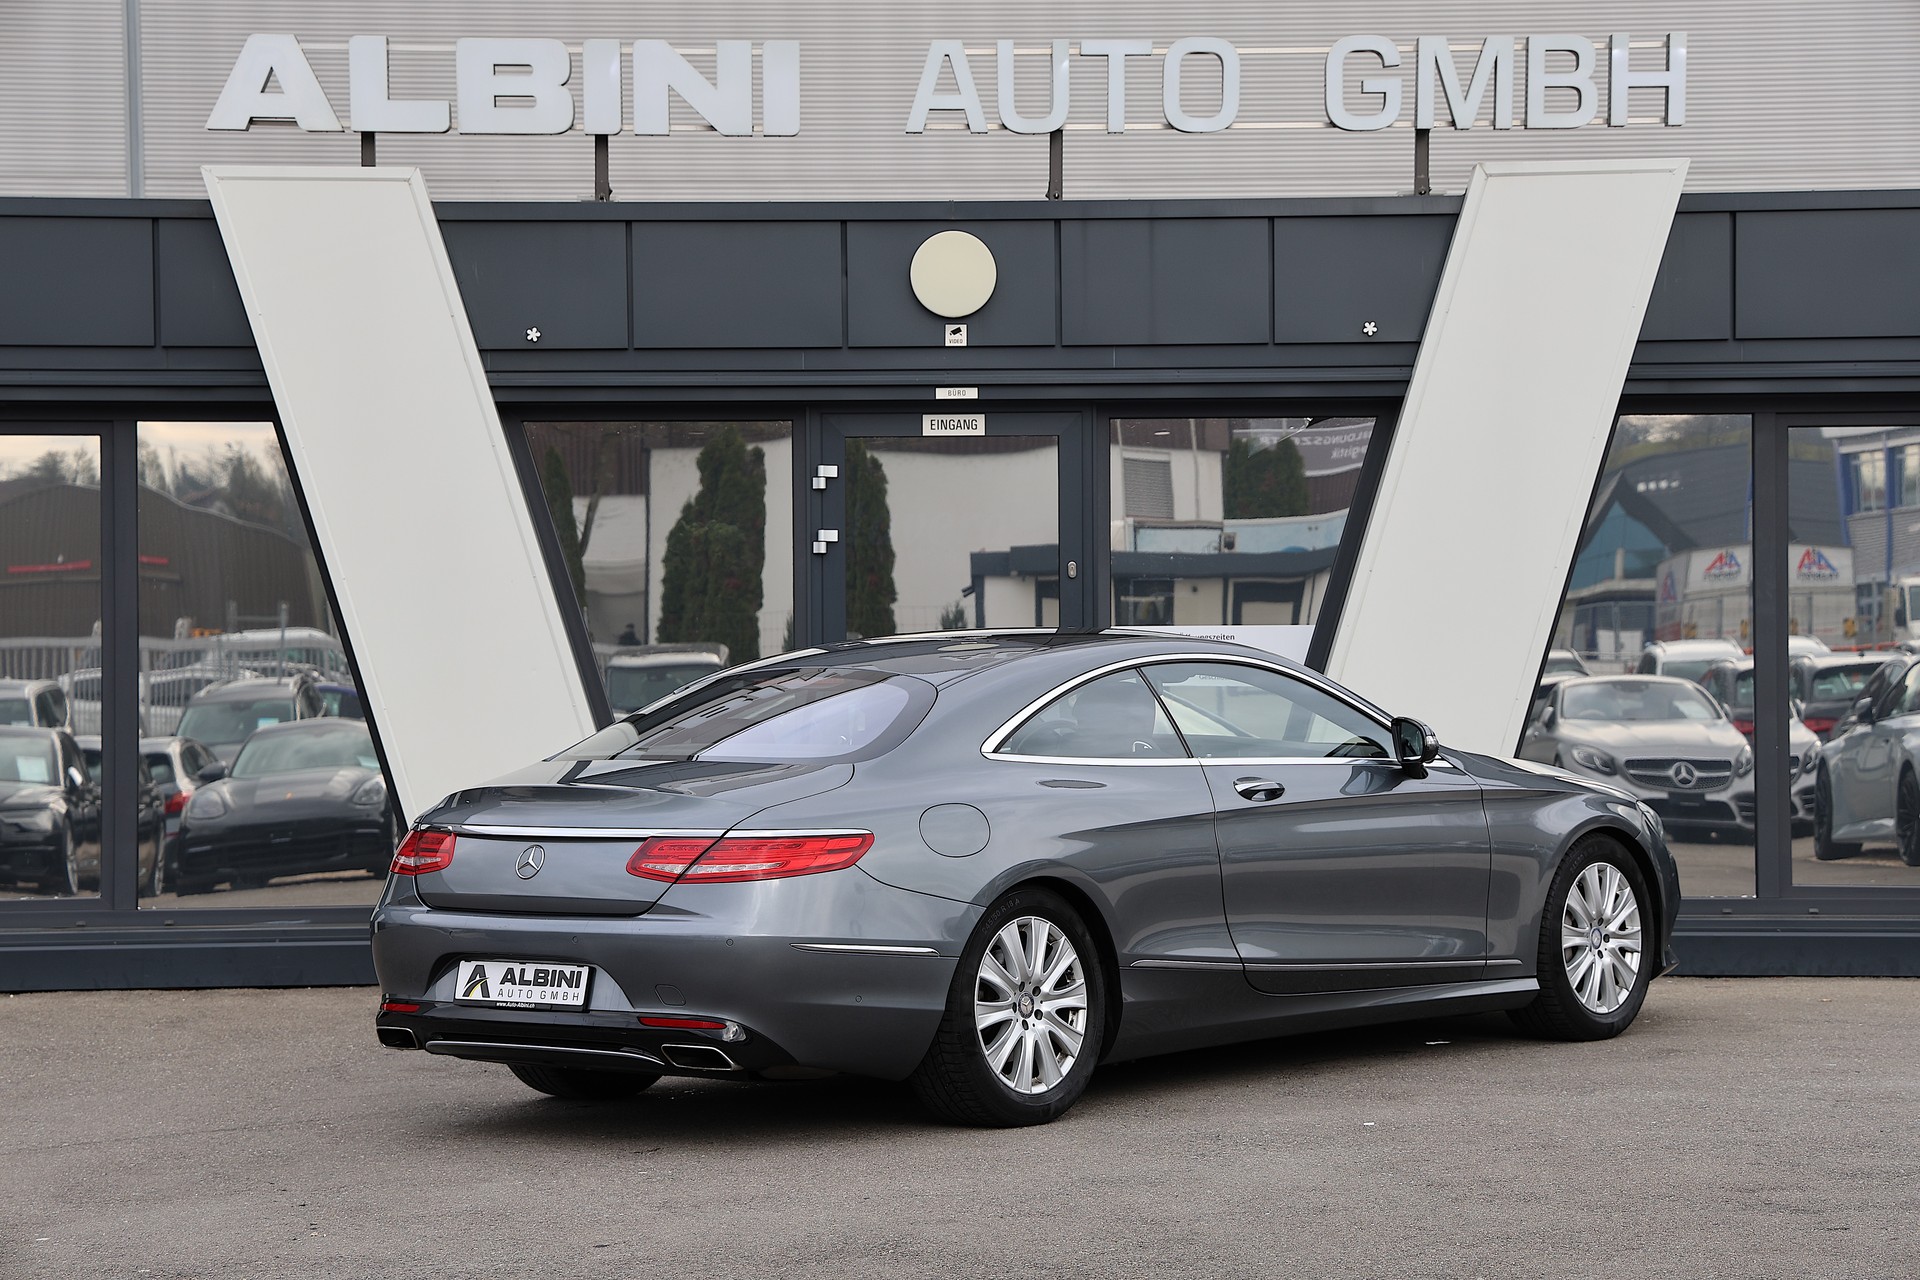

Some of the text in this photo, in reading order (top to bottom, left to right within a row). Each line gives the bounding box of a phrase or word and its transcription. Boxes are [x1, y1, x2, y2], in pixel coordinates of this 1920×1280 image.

[205, 31, 1688, 137] ALBINI AUTO GMBH
[947, 388, 967, 397] BÜRO
[930, 418, 978, 431] EINGANG
[499, 967, 583, 989] ALBINI
[497, 988, 580, 1002] AUTO GMBH
